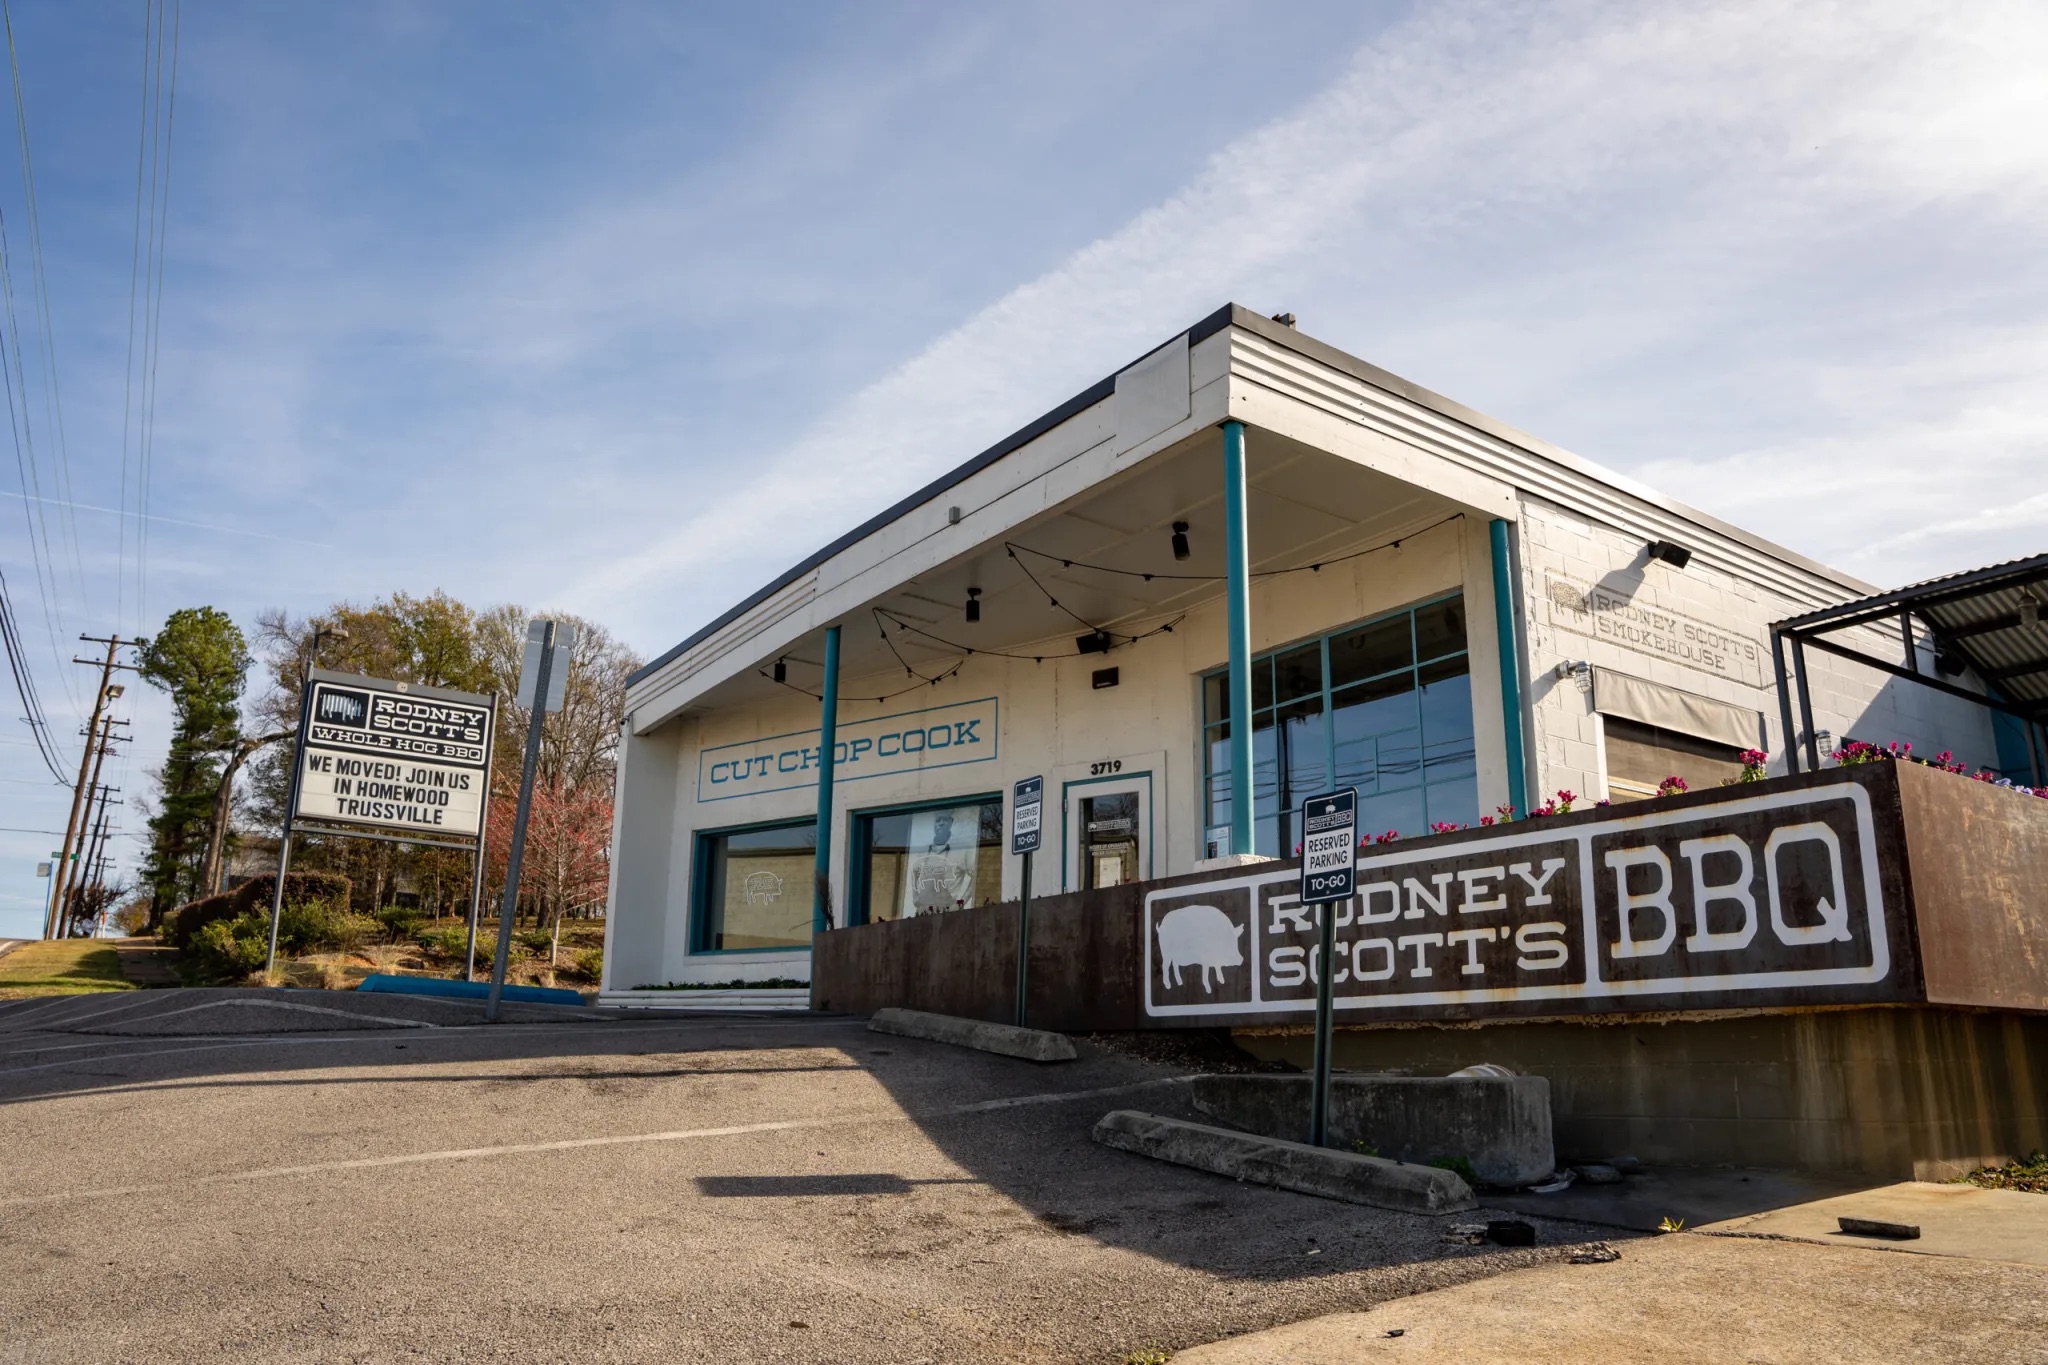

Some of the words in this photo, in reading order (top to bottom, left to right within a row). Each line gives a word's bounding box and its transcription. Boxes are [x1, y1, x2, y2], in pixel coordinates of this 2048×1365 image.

[1596, 593, 1676, 634] RODNEY
[1684, 623, 1755, 661] SCOTT'S
[1599, 617, 1726, 670] SMOKEHOUSE
[375, 699, 483, 725] RODNEY
[373, 715, 481, 741] SCOTT'S
[314, 727, 392, 747] WHOLE
[396, 739, 438, 753] HOG
[442, 745, 481, 760] BBQ
[710, 755, 774, 784] CUT
[878, 719, 981, 757] COOK
[309, 754, 332, 773] WE
[336, 758, 401, 782] MOVED!
[405, 768, 445, 788] JOIN
[449, 773, 470, 790] US
[1090, 760, 1122, 775] 3719
[334, 778, 352, 796] IN
[356, 780, 450, 807] HOMEWOOD
[336, 798, 443, 825] TRUSSVILLE
[1016, 806, 1039, 820] RESERVED
[1016, 817, 1037, 831] PARKING
[1017, 833, 1036, 846] TO-GO
[1308, 833, 1350, 854] RESERVED
[1310, 850, 1348, 869] PARKING
[1311, 874, 1346, 891] TO-GO
[1604, 821, 1853, 959] BBQ
[1269, 921, 1569, 987] SCOTT'S
